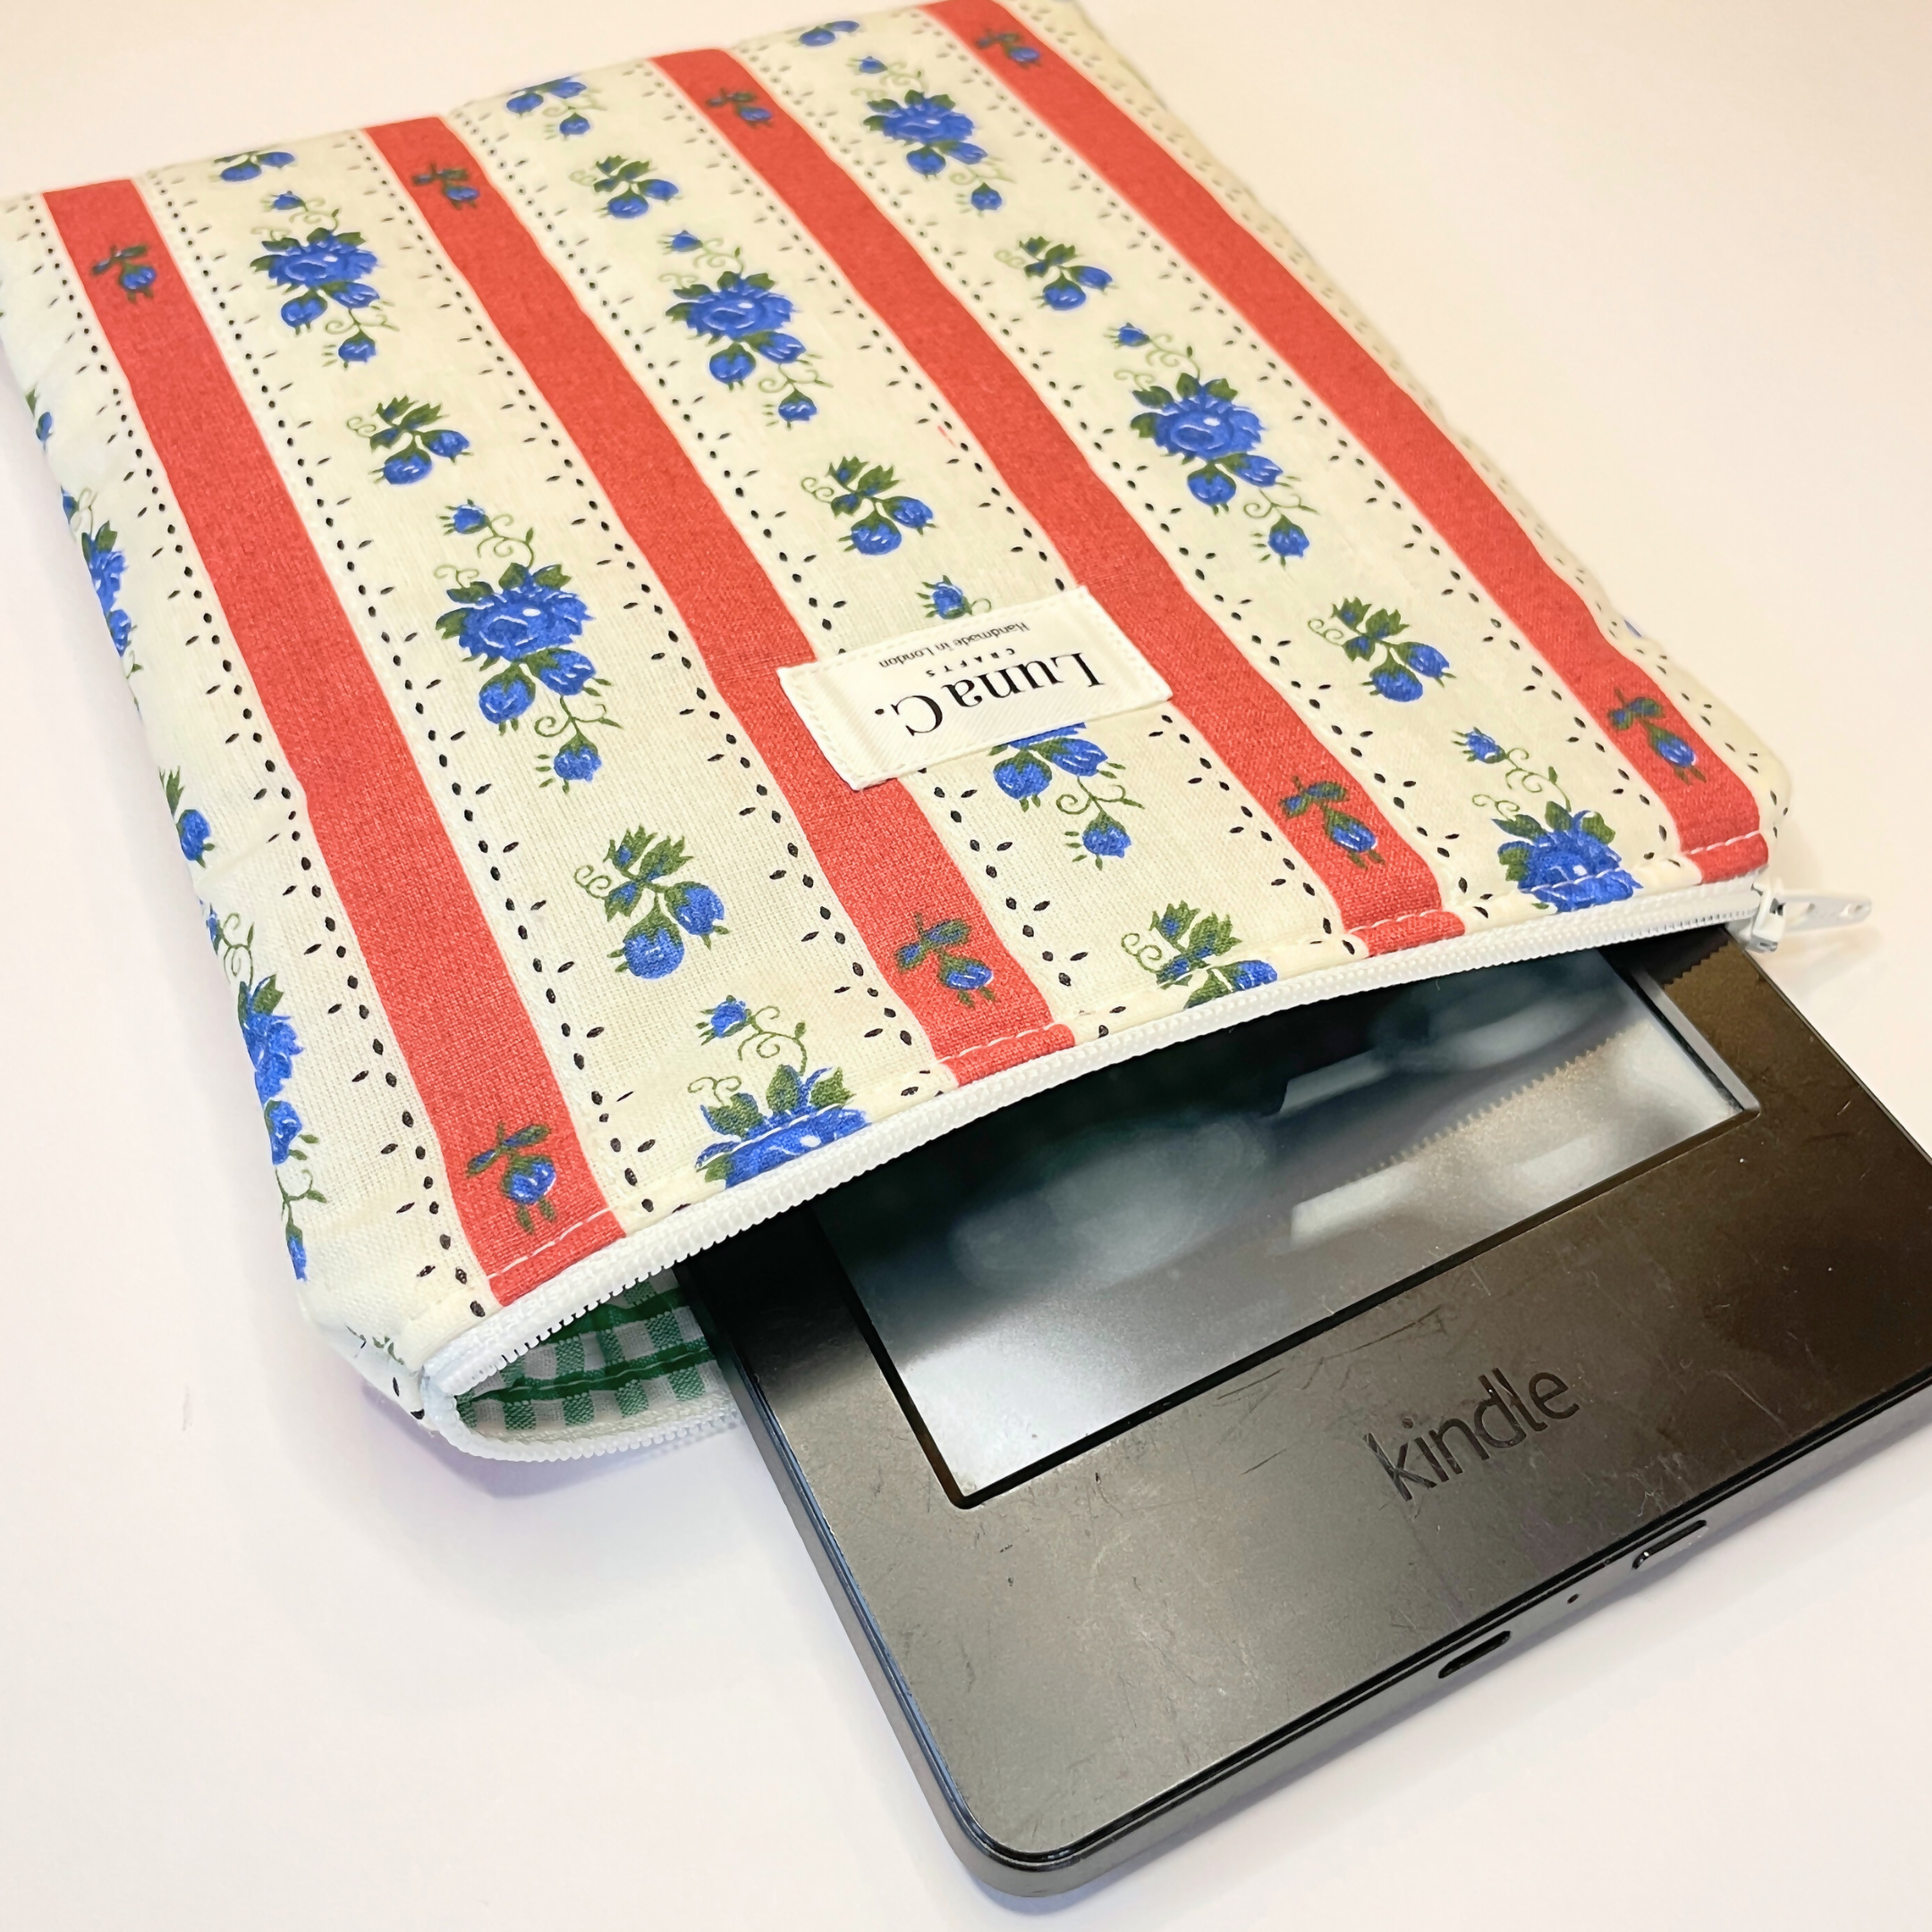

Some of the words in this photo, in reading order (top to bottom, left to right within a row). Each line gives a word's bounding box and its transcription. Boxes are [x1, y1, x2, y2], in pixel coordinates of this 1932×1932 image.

[934, 640, 951, 653] in
[953, 622, 1030, 647] Handmade
[878, 647, 934, 668] London
[926, 648, 1016, 677] CRAFTS
[940, 652, 1106, 708] Luna
[874, 695, 944, 737] C.
[1362, 1368, 1580, 1501] kindle
